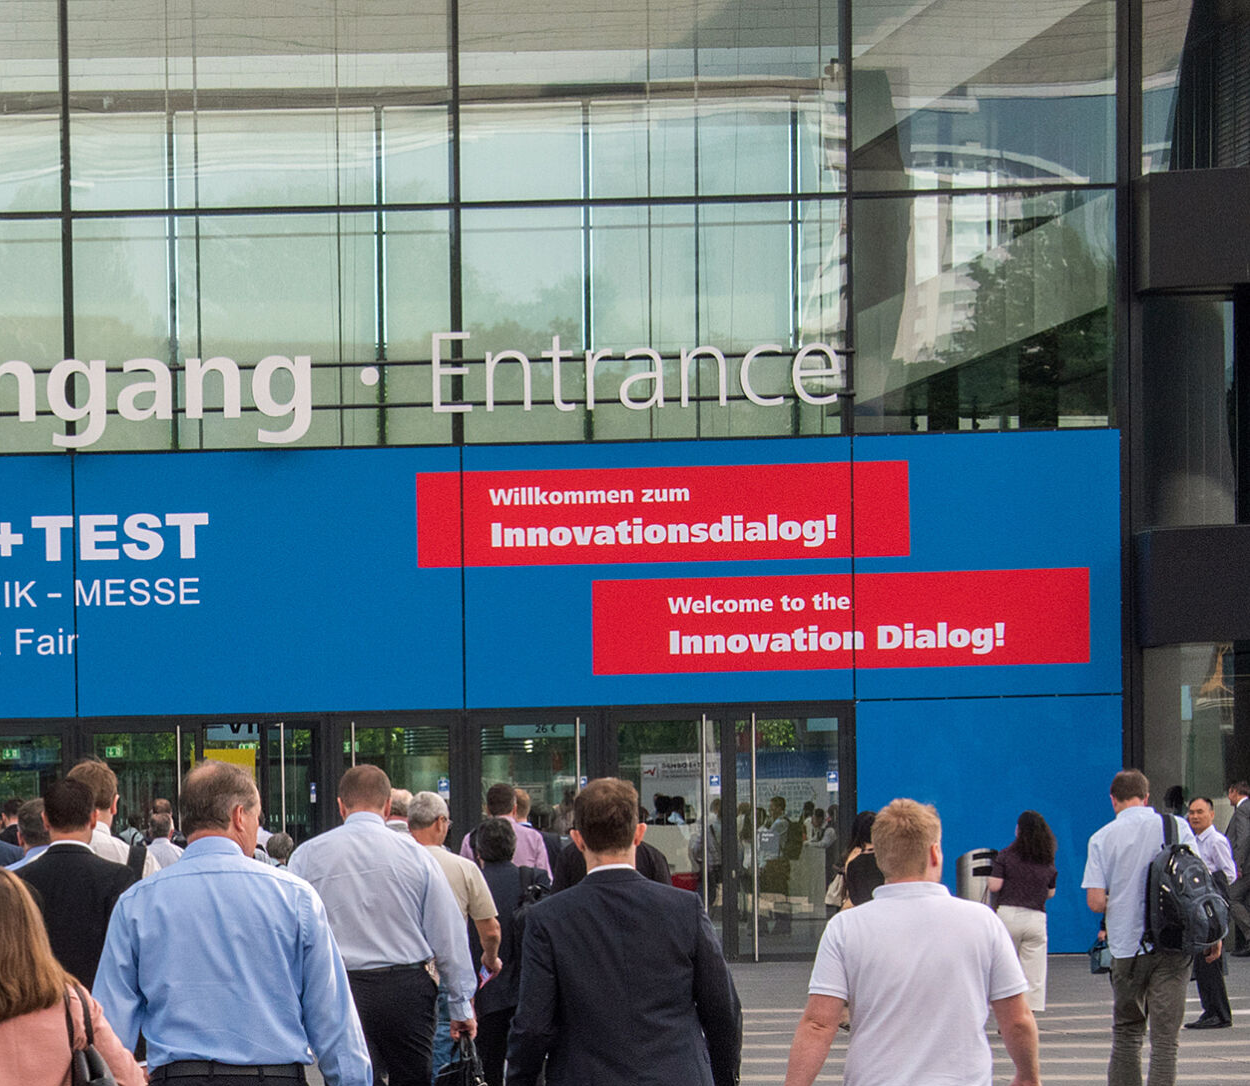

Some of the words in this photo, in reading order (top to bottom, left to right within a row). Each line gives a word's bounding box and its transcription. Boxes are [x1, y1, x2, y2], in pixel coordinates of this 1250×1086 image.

[431, 331, 841, 413] Entrance
[488, 486, 634, 506] Willkommen
[641, 487, 690, 503] zum
[490, 513, 837, 548] Innovationsdialog!
[75, 577, 200, 608] MESSE
[667, 595, 774, 615] Welcome
[779, 594, 806, 612] to
[811, 591, 851, 611] the
[15, 627, 77, 656] Fair
[669, 625, 864, 656] Innovation
[876, 621, 1005, 655] Dialog!
